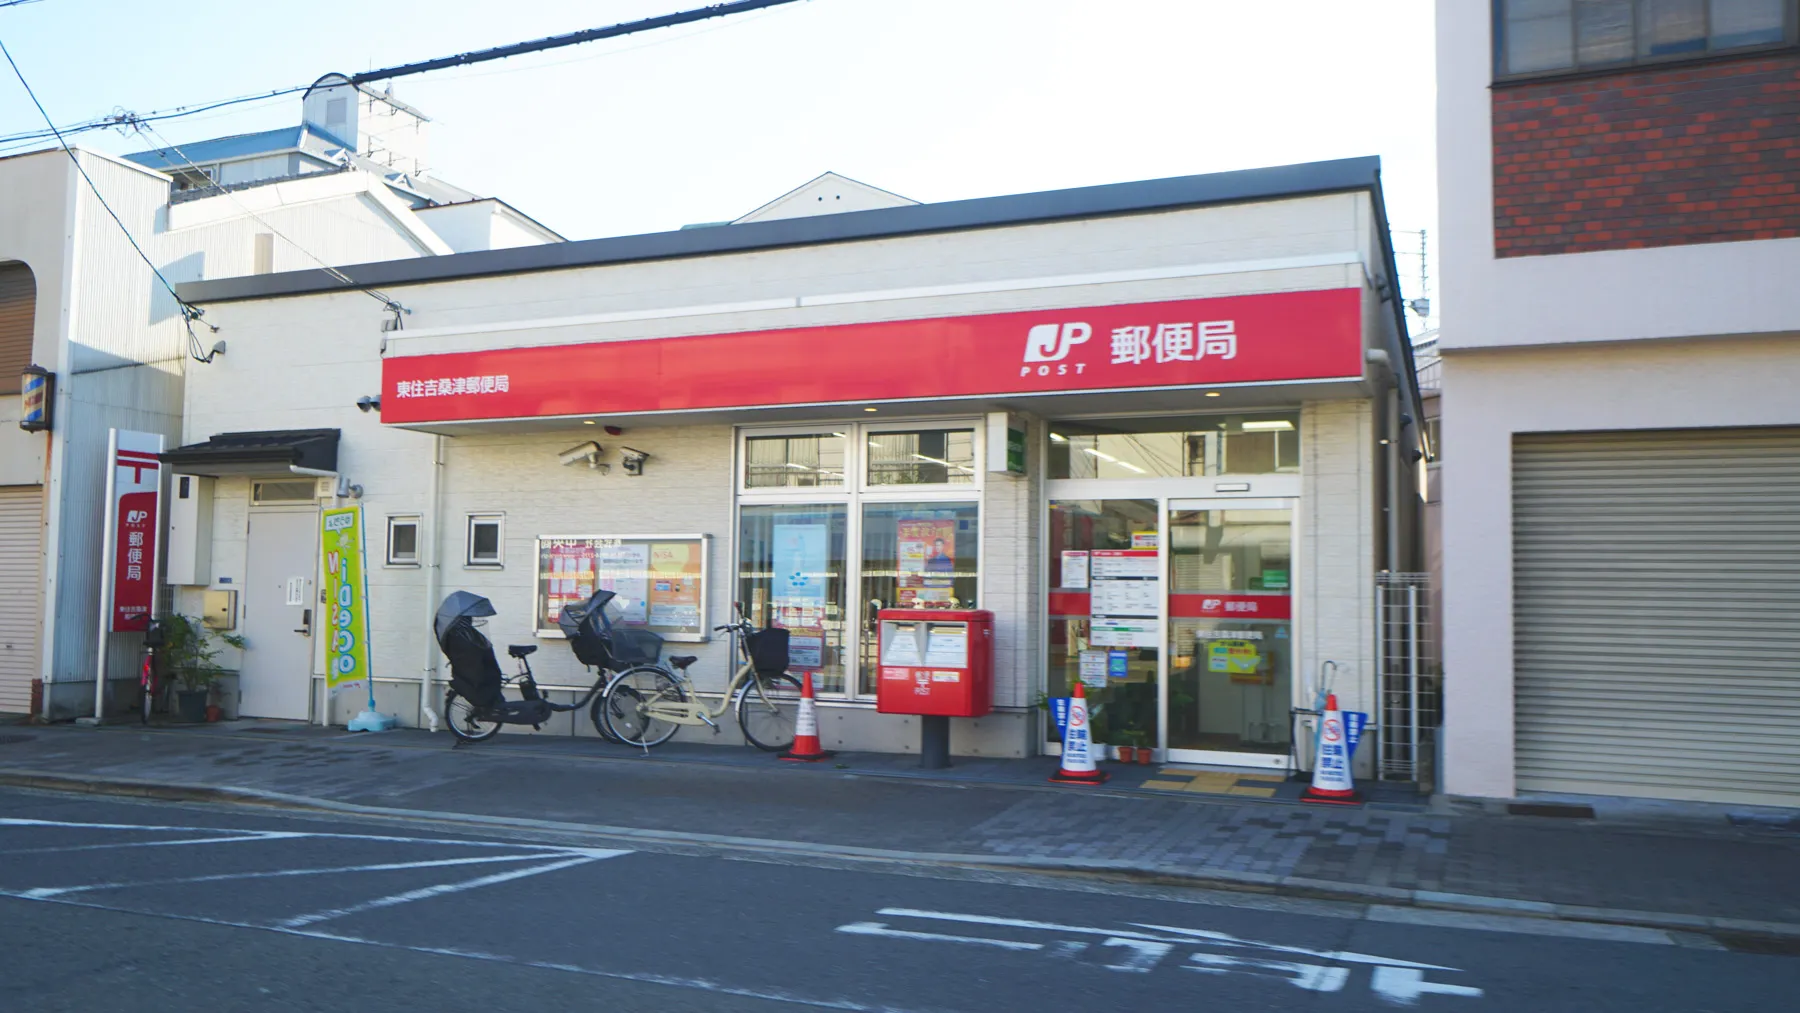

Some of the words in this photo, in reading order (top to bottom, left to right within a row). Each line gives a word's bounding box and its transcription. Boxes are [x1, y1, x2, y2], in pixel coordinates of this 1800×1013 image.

[1110, 320, 1238, 365] 郵便局
[396, 375, 510, 398] 東住吉桑津郵便局
[1020, 363, 1087, 377] POST
[126, 531, 143, 581] 郵便局
